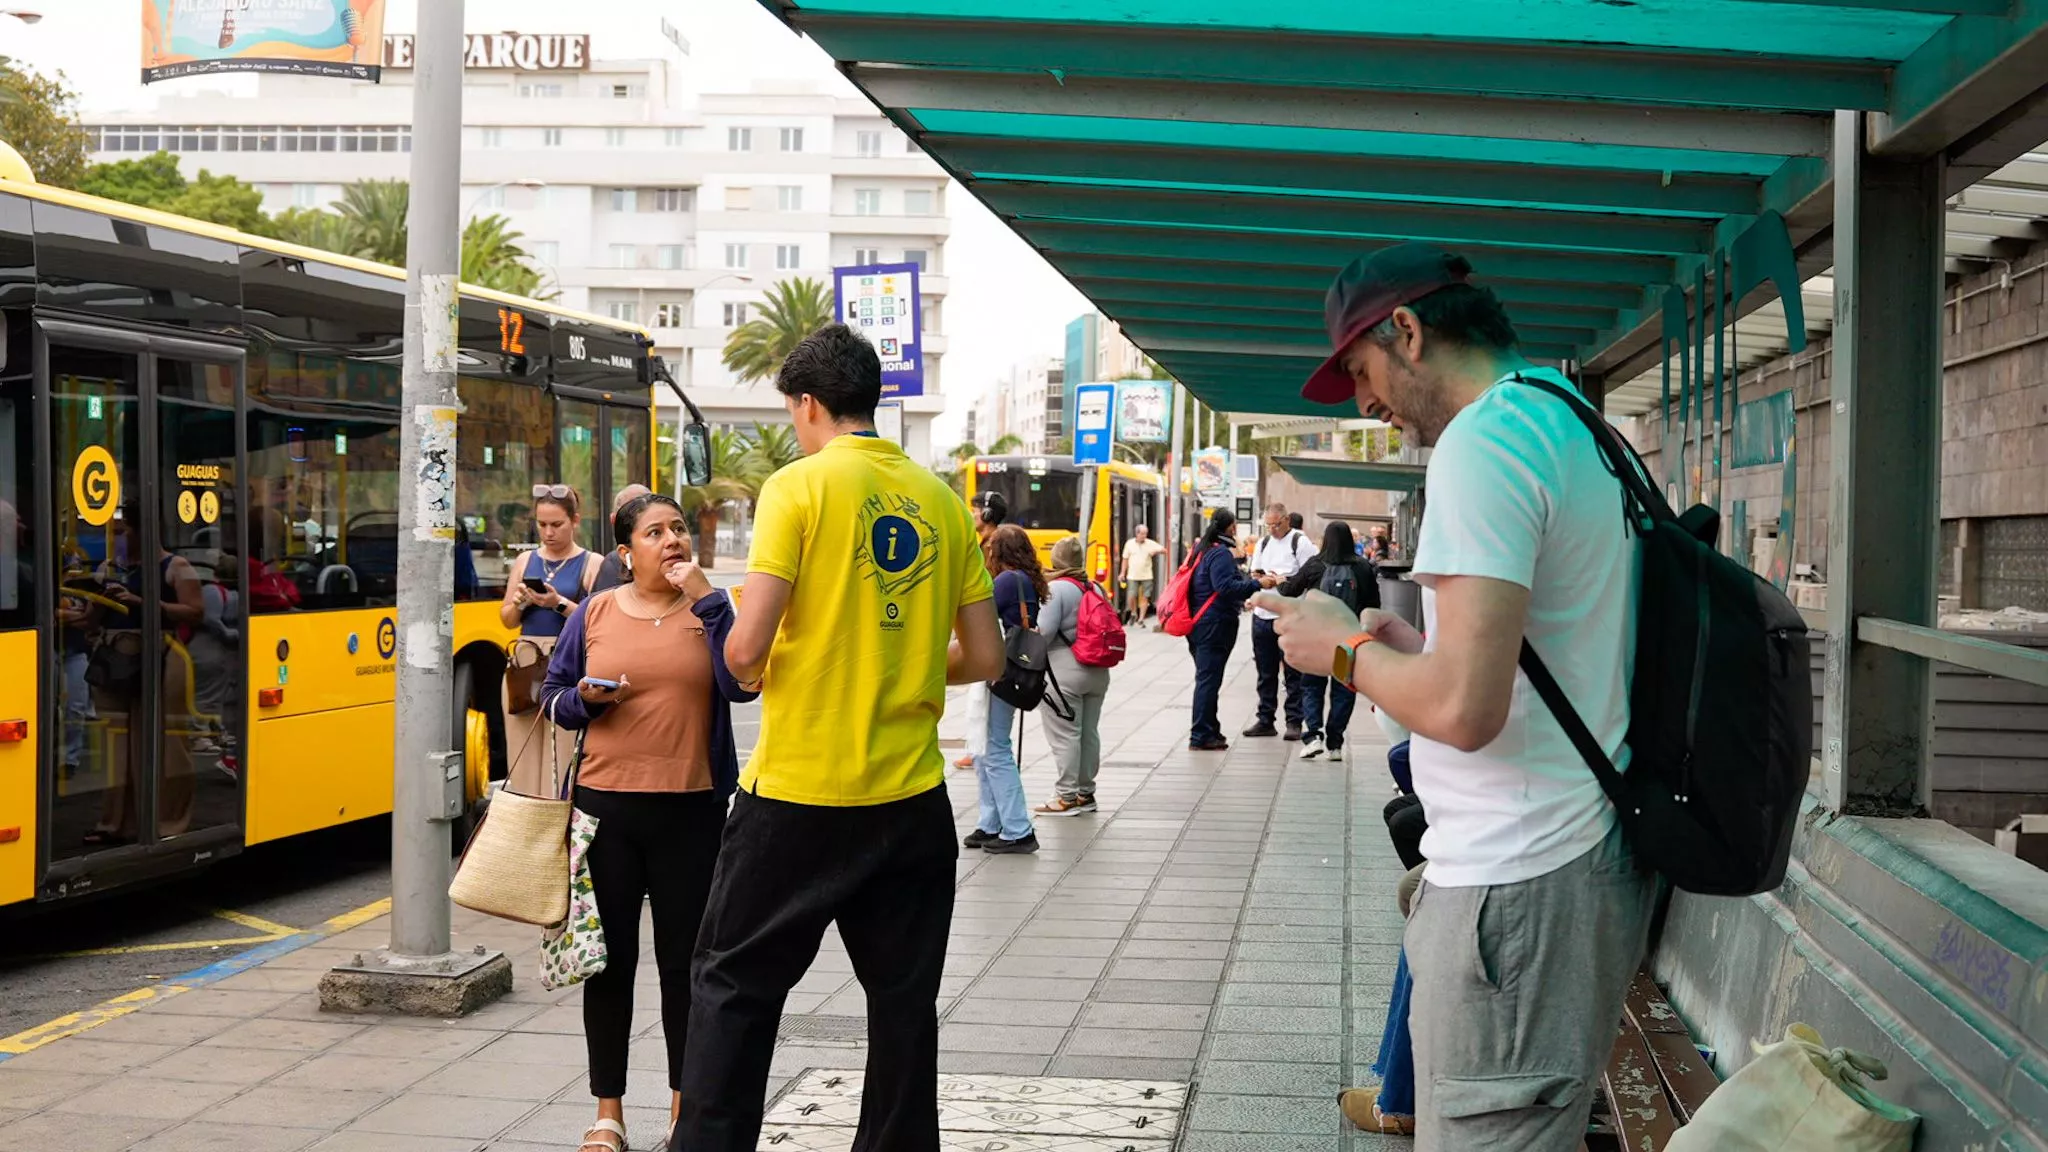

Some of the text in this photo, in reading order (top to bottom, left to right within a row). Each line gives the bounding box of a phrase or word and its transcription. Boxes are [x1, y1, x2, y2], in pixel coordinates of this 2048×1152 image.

[498, 308, 526, 355] 12
[569, 335, 587, 361] 805
[611, 355, 633, 369] MAN
[176, 463, 220, 480] GUAGUAS
